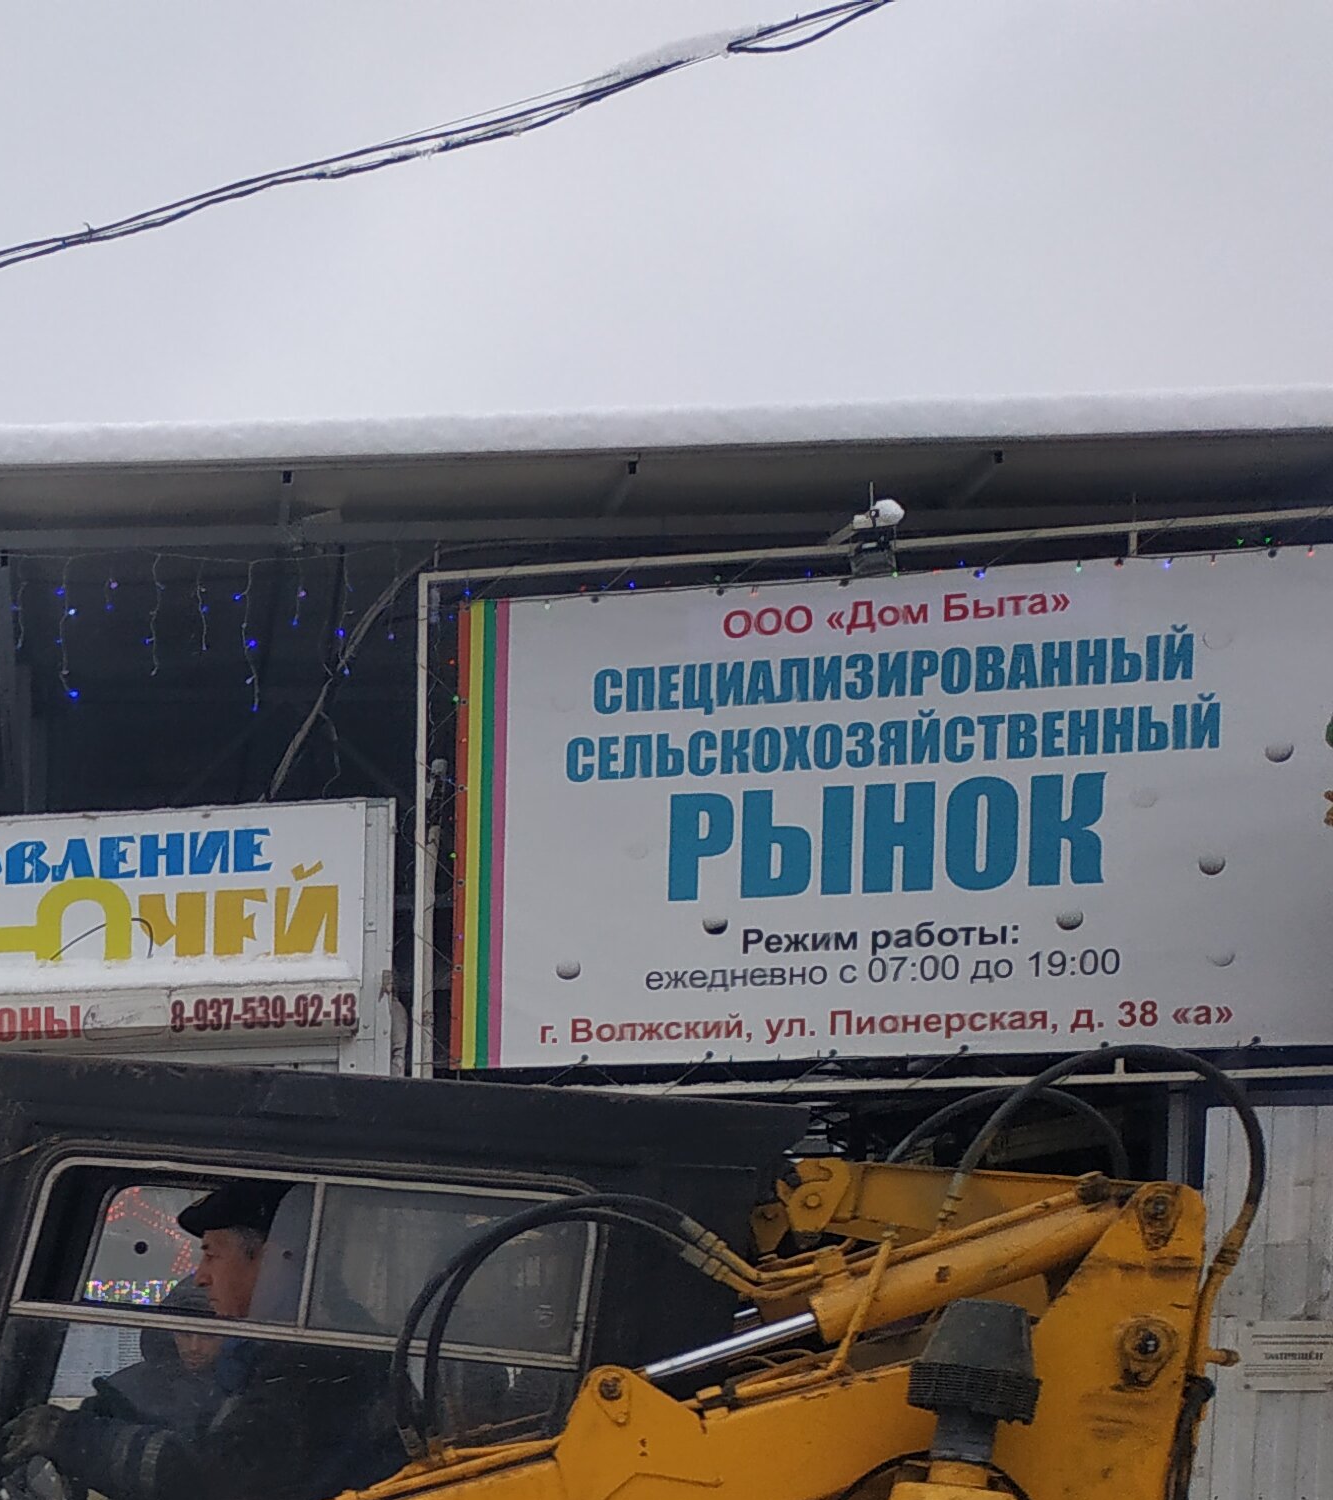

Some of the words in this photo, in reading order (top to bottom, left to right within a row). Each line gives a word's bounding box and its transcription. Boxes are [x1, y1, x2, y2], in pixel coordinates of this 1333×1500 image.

[722, 604, 814, 639] ООО
[826, 596, 930, 636] «Дом
[943, 590, 1071, 623] Быта»
[592, 623, 1195, 716] СПЕЦИАЛИЗИРОВАННЫЙ
[565, 692, 1222, 783] СЕЛЬСКОХОЗЯЙСТВЕННЫЙ
[667, 771, 1109, 902] РЫНОК
[741, 926, 859, 955] Режим
[870, 920, 1022, 958] работы:
[645, 962, 829, 994] ежедневно
[839, 964, 857, 985] с
[867, 954, 961, 985] 07:00
[969, 955, 1014, 987] до
[1028, 947, 1122, 979] 19:00
[170, 991, 359, 1033] 8-937-539-92-13
[540, 1022, 559, 1045] г.
[569, 1011, 754, 1046] Волжский,
[765, 1017, 817, 1048] ул.
[829, 1007, 1059, 1043] Пионерская,
[1069, 1006, 1106, 1034] д.
[1116, 1000, 1159, 1029] 38
[1172, 1001, 1235, 1027] «а»
